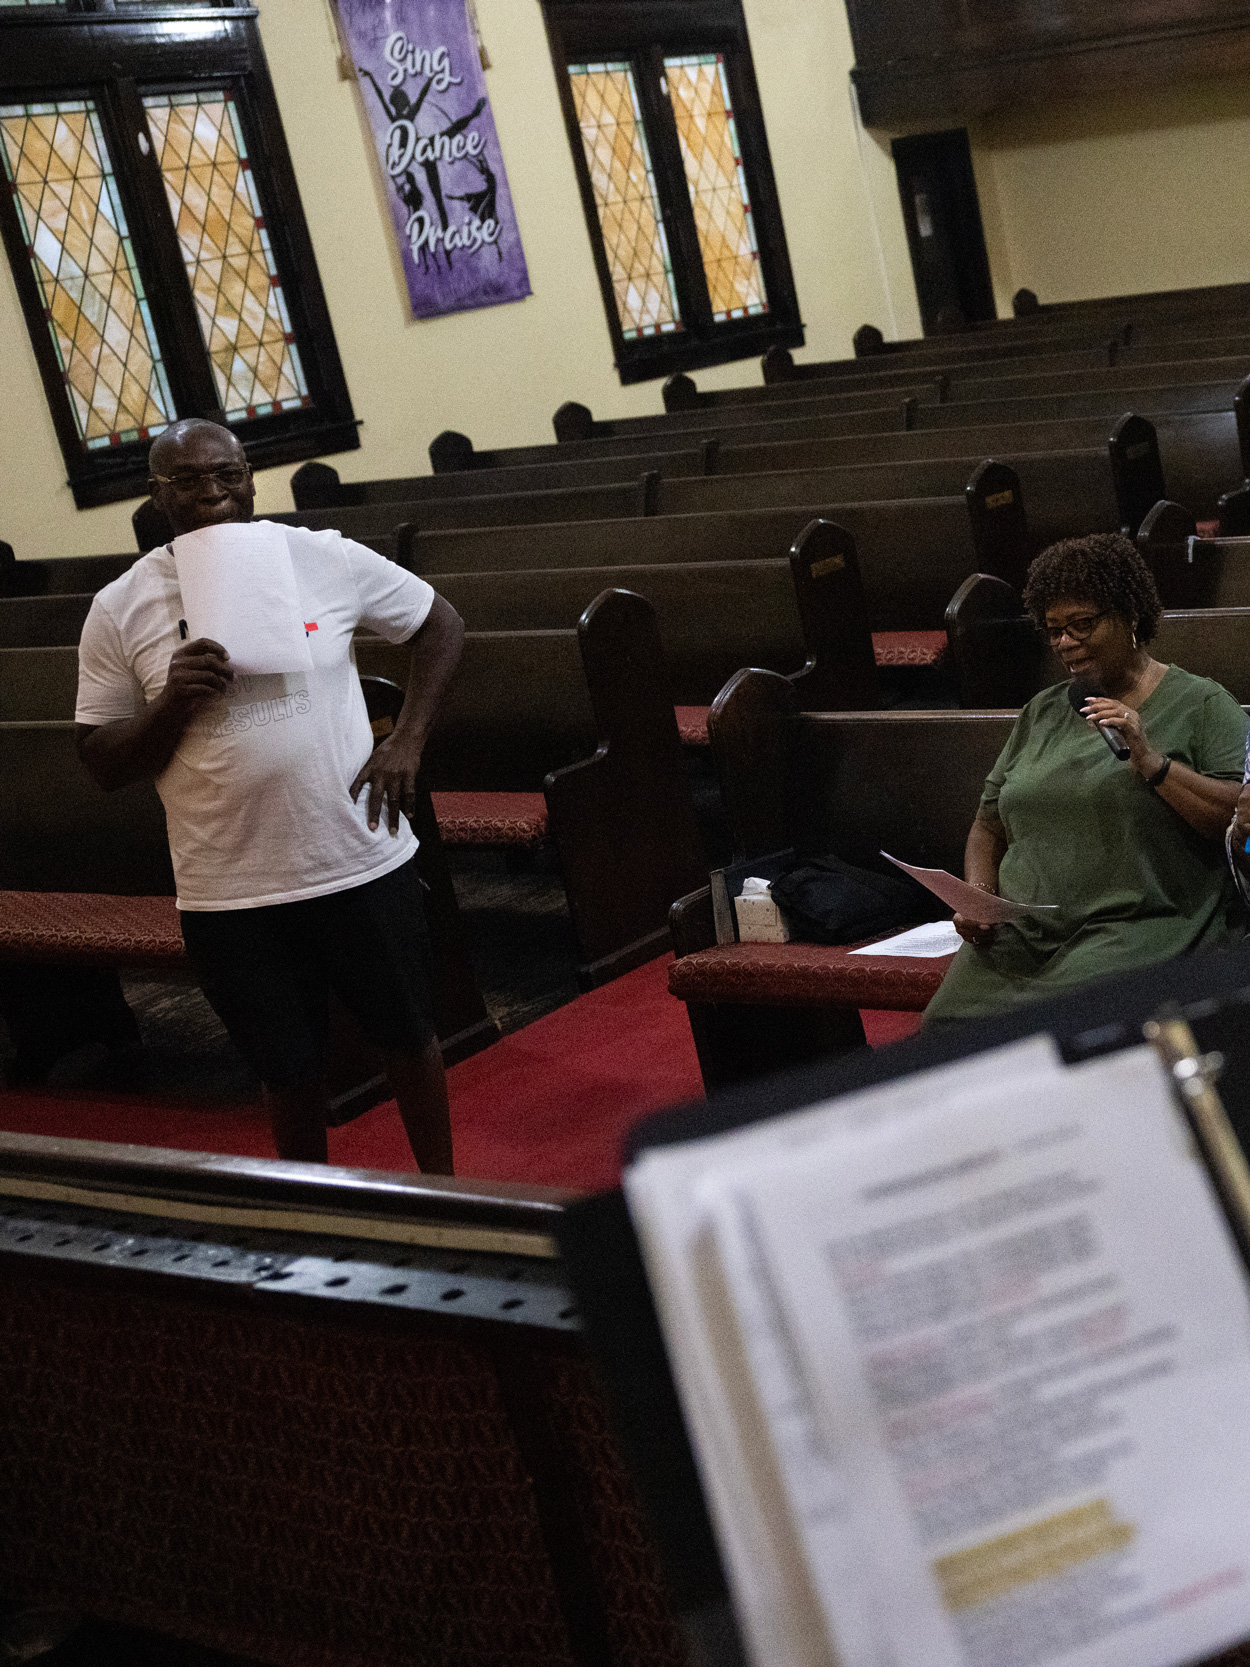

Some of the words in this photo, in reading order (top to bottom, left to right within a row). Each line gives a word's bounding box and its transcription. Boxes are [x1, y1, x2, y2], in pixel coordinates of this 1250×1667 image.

[384, 31, 462, 92] Sing
[386, 119, 485, 176] Dance
[406, 210, 500, 265] Praise
[202, 689, 311, 740] RESULTS
